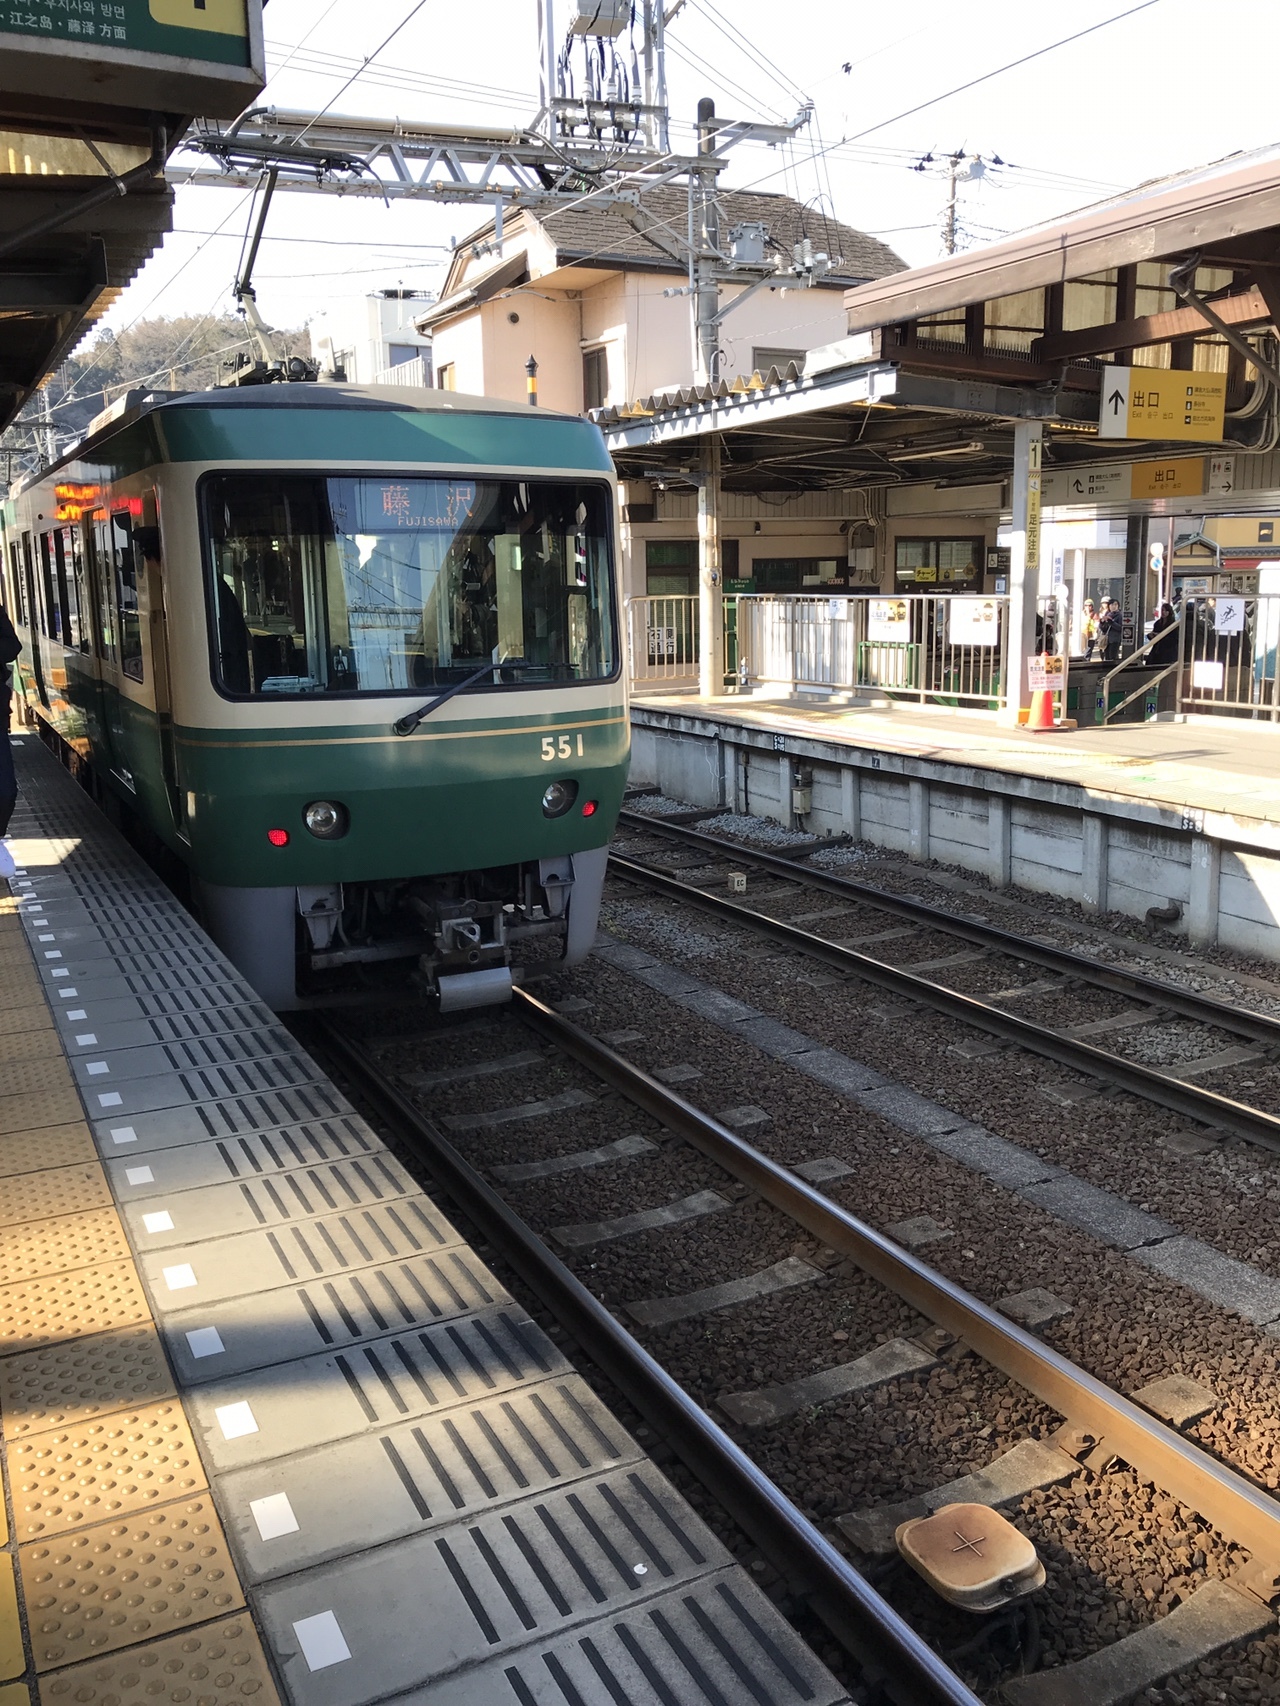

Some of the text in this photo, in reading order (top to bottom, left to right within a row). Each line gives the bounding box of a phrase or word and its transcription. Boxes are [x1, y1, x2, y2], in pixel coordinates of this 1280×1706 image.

[100, 2, 126, 20] 방면
[98, 23, 127, 40] 方面
[1132, 390, 1160, 408] 出口
[1031, 444, 1038, 468] 1
[1154, 469, 1176, 483] 出口
[397, 516, 459, 527] FUJISAWA
[1027, 514, 1038, 564] 足元注意
[916, 569, 936, 577] チャージ
[540, 733, 585, 762] 551
[736, 879, 745, 887] EC
